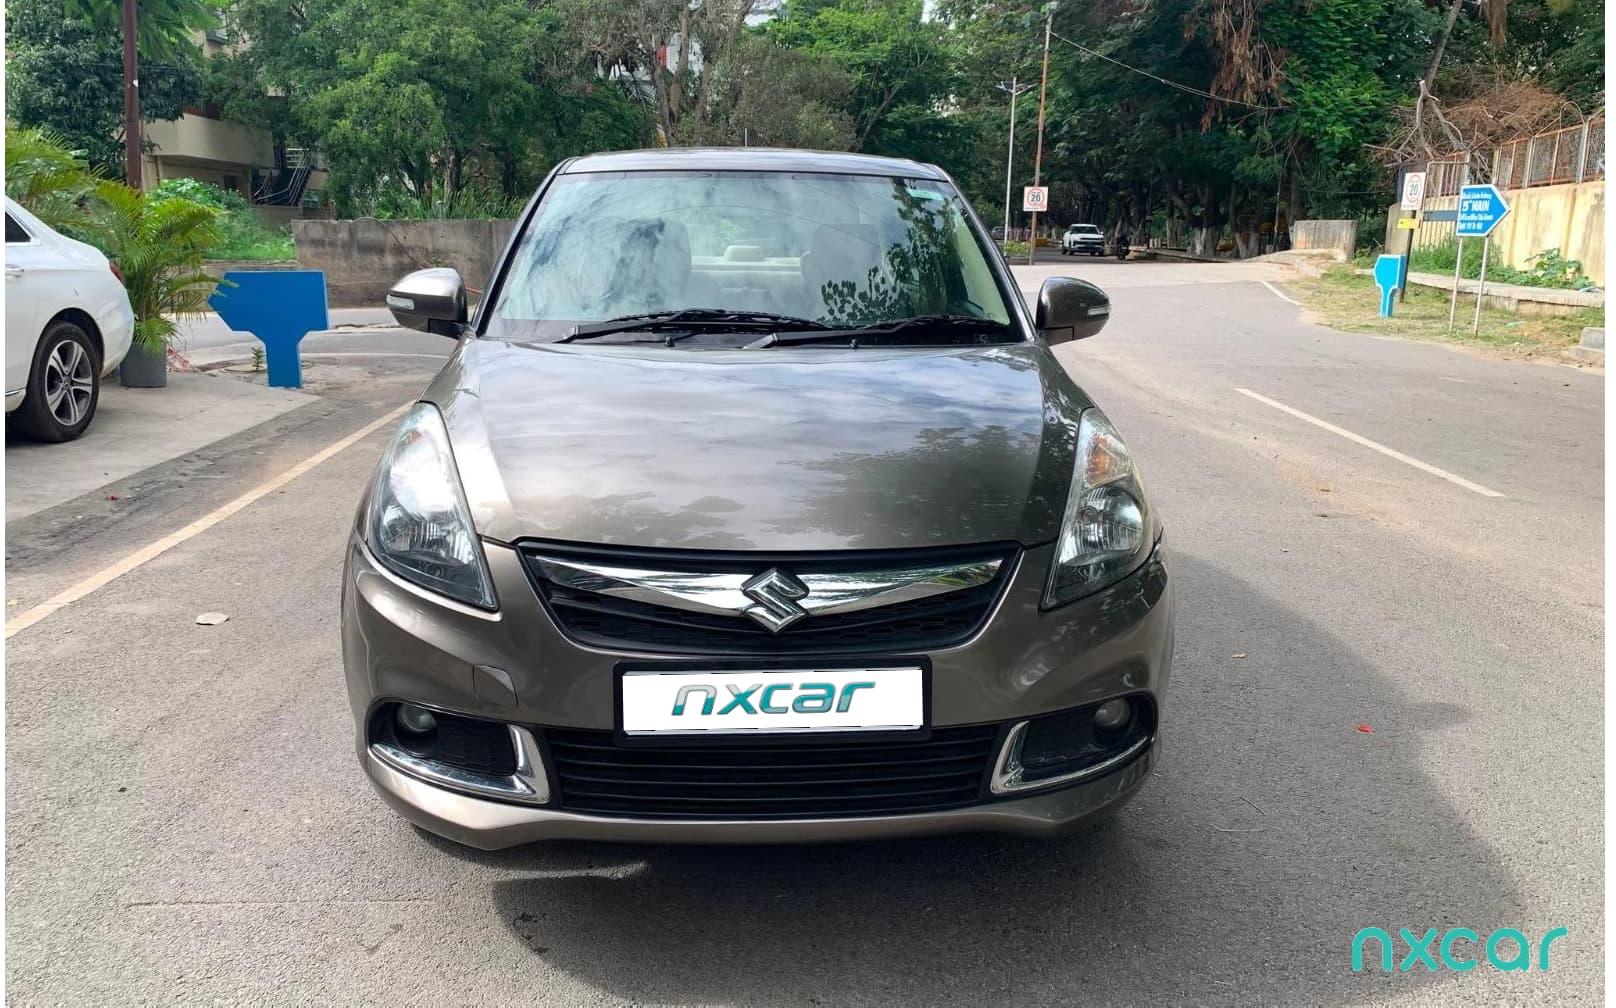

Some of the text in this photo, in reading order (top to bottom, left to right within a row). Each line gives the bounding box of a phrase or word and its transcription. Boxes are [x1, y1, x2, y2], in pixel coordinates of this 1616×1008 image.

[1409, 184, 1419, 196] 20
[1031, 194, 1041, 202] 20
[1472, 199, 1490, 212] MAIN
